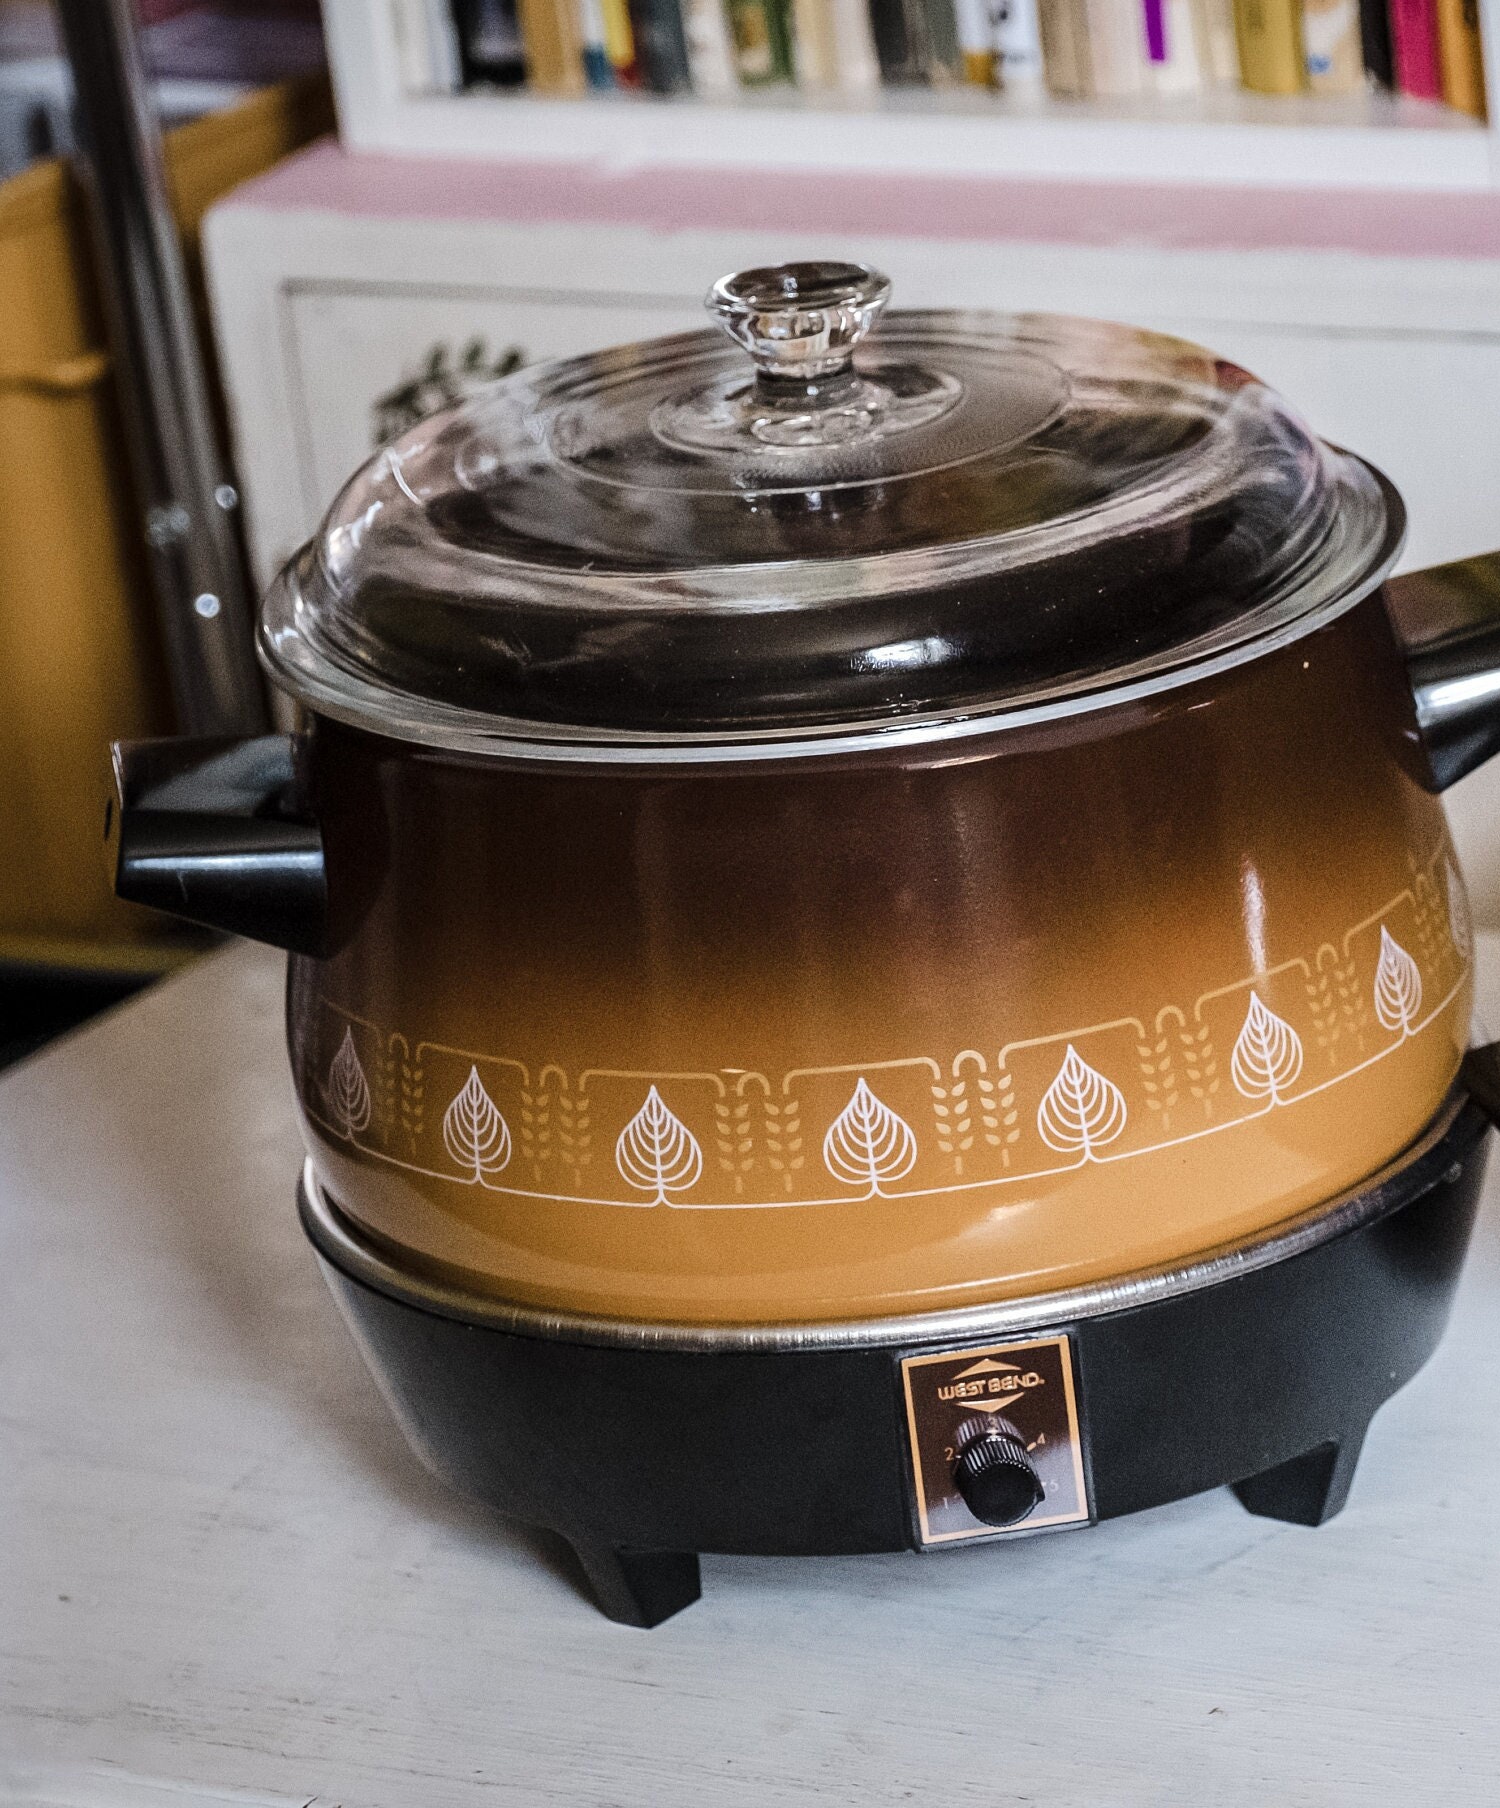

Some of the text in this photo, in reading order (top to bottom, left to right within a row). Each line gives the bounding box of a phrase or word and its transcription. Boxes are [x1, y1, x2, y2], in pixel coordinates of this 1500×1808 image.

[937, 1380, 986, 1400] WEST
[1036, 1433, 1046, 1445] 4
[944, 1447, 954, 1461] 2
